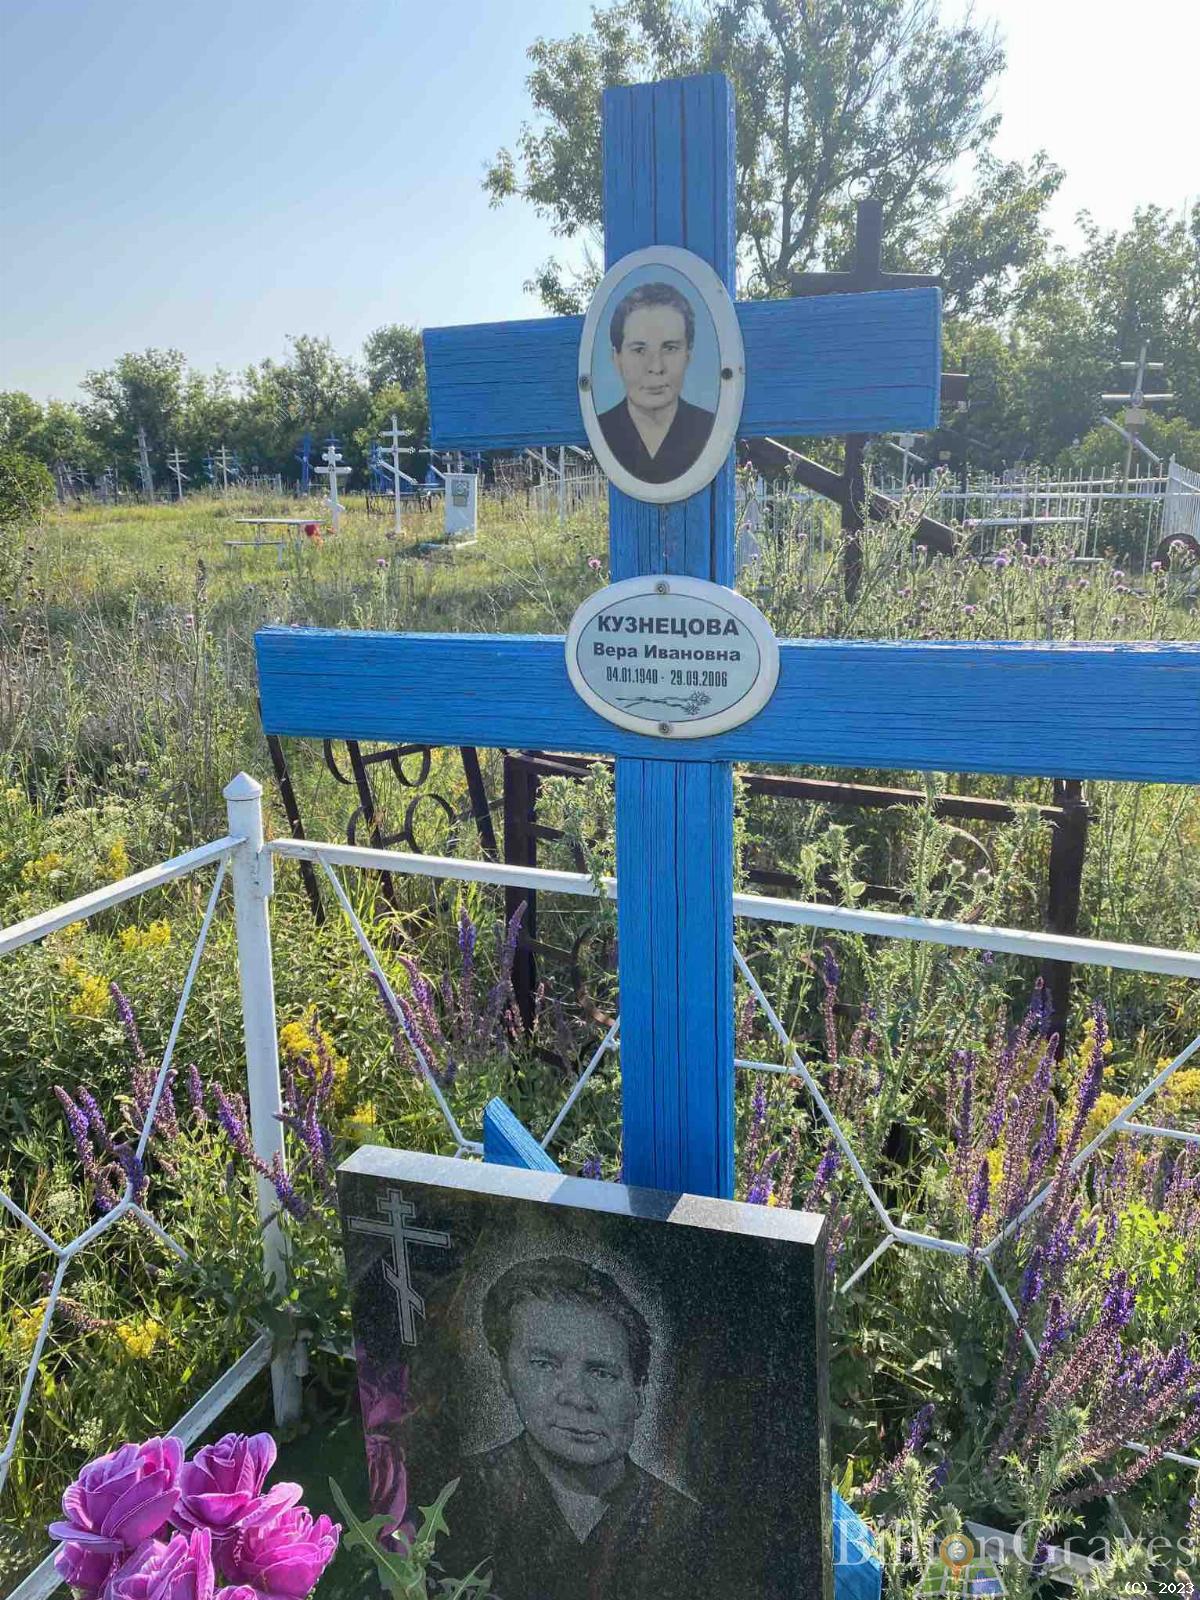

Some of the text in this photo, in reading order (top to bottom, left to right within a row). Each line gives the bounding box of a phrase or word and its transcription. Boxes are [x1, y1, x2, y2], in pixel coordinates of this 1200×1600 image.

[598, 615, 740, 638] КУЗНЕЦОВА
[593, 642, 741, 661] Вера Ивановна
[606, 666, 658, 684] 04.01.1940
[670, 669, 728, 687] 29.09.2006
